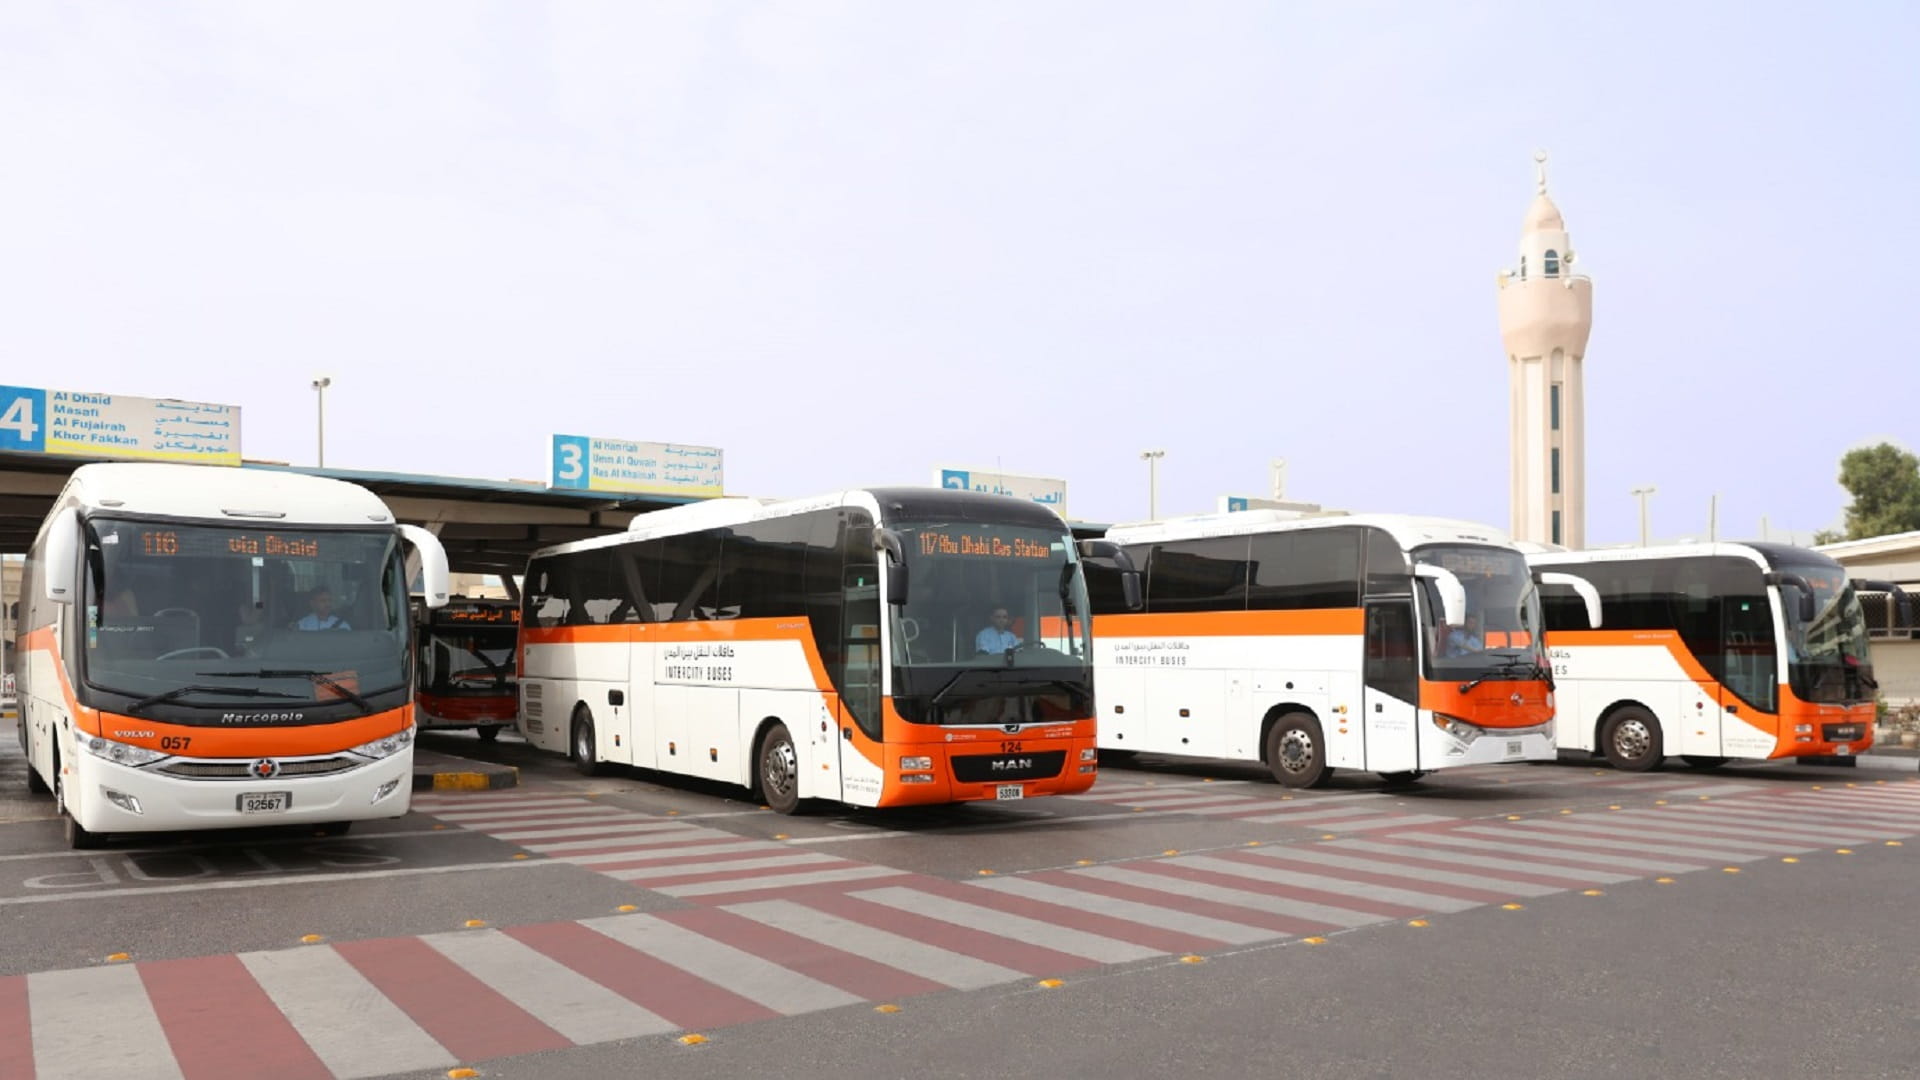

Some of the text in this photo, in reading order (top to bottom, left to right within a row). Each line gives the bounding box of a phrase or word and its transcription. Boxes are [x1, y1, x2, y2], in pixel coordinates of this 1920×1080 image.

[53, 391, 112, 405] Al Dhaid
[53, 404, 99, 417] Masafi
[0, 397, 38, 442] 4
[53, 417, 126, 433] Al Fujairah
[53, 430, 139, 446] Khor Fakkan
[593, 441, 602, 450] Al
[559, 444, 583, 480] 3
[616, 457, 625, 465] Al
[611, 469, 620, 478] Al
[141, 532, 318, 557] 116 via Dhaid
[920, 532, 1049, 558] 117 Abu Dhabi Bus Station
[665, 666, 732, 681] INTERCITY BUSES
[221, 712, 303, 724] Marcopolo
[114, 730, 155, 739] VOLVO
[161, 737, 191, 750] 057
[1000, 741, 1022, 753] 124
[992, 759, 1033, 771] MAN
[247, 798, 281, 812] 92567
